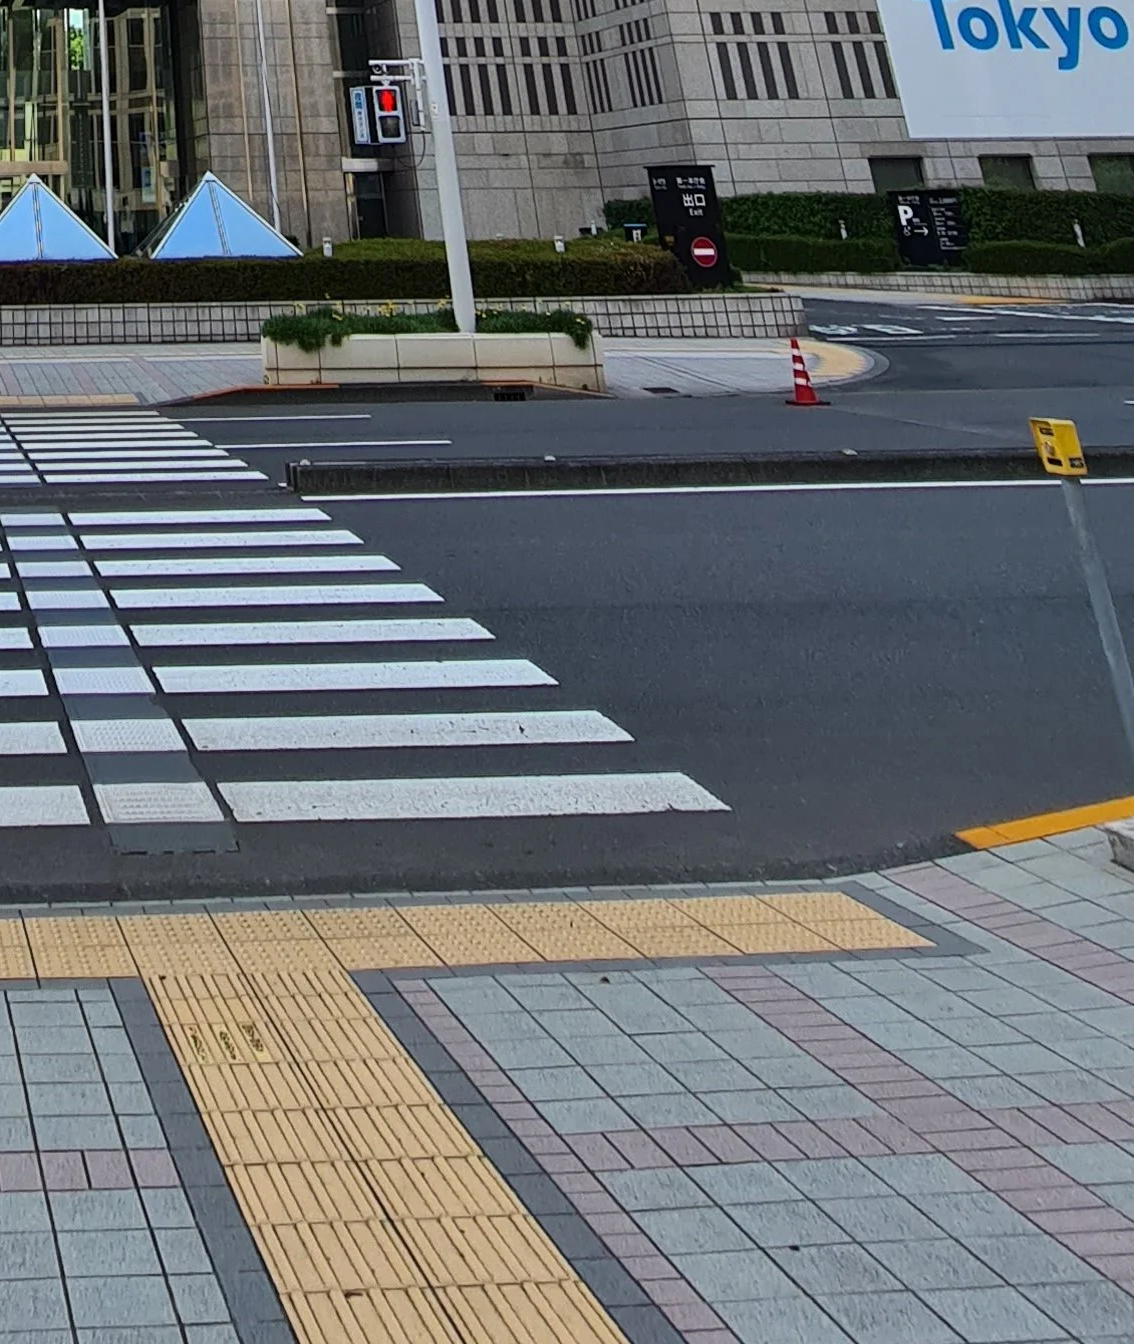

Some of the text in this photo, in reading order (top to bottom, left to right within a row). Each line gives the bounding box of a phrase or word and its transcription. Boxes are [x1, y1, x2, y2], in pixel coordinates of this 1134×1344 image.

[682, 193, 706, 207] 出口
[688, 208, 704, 217] Exit
[897, 205, 914, 226] P
